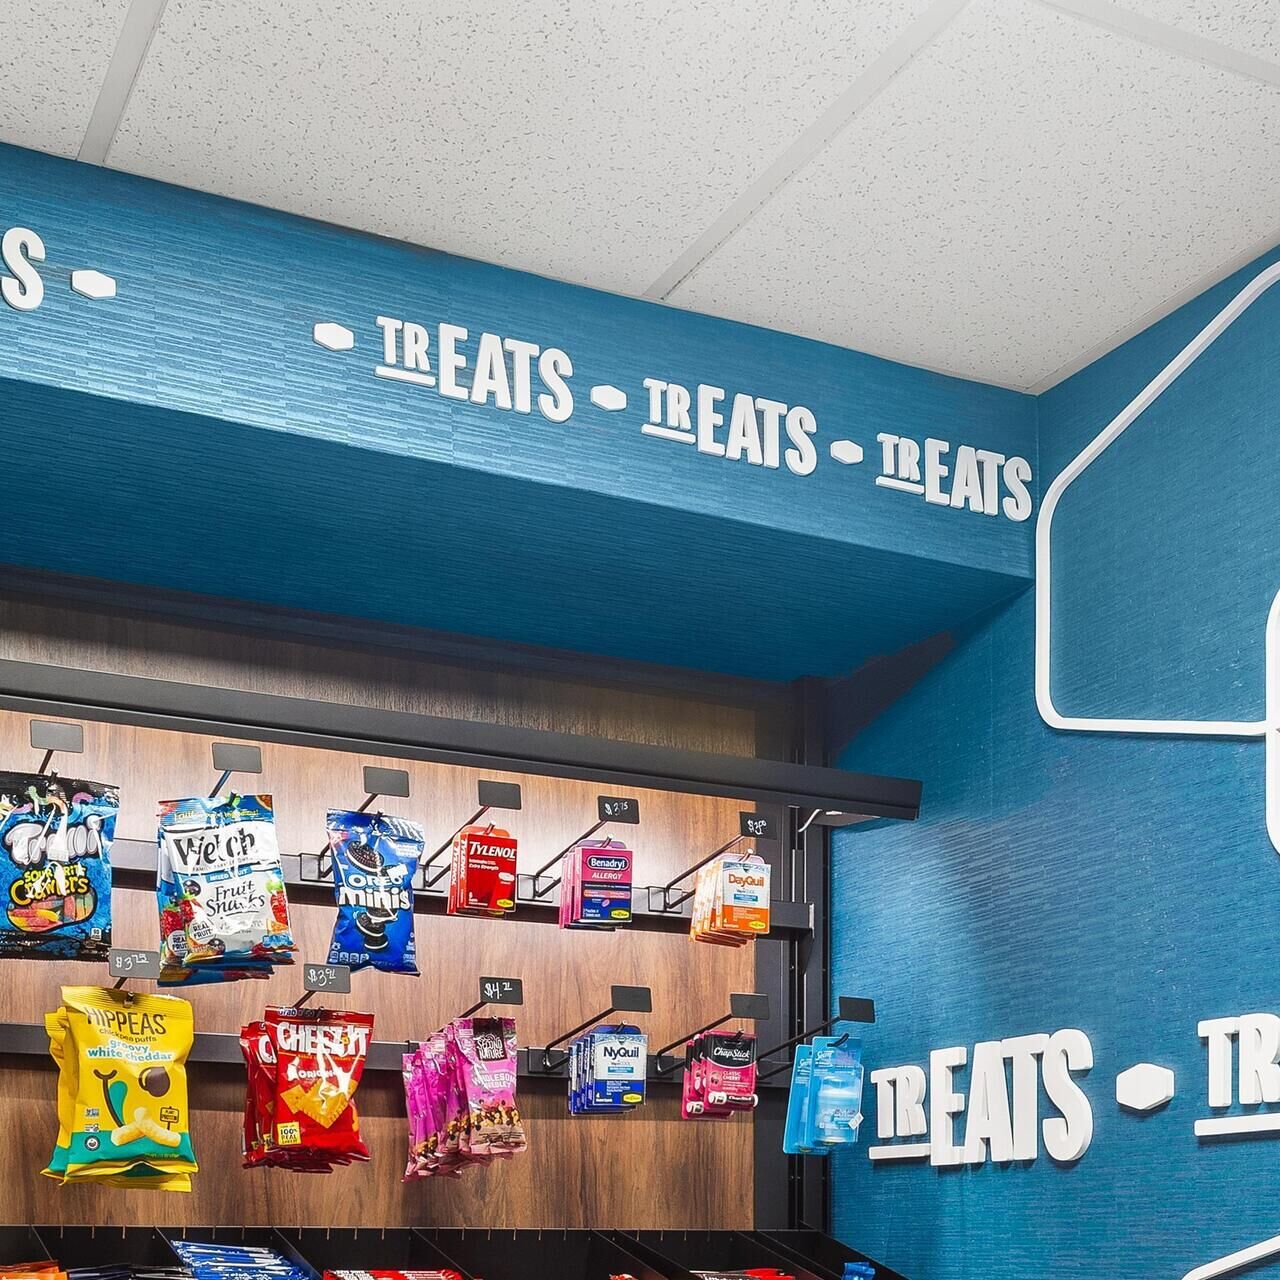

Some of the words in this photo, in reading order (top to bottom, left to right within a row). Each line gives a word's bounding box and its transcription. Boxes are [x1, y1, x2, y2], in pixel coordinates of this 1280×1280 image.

[375, 316, 574, 422] TREATS
[641, 378, 818, 476] TREATS
[876, 432, 1033, 522] TREATS
[469, 841, 517, 859] TYLENOL
[591, 857, 626, 870] Benadryl
[592, 872, 623, 880] ALLERGY
[728, 873, 765, 888] DayQuil
[215, 880, 255, 902] Fruit
[339, 886, 411, 909] minis
[192, 921, 210, 933] REAL
[193, 928, 213, 940] FRUIT
[84, 1006, 167, 1035] HIPPEAS
[476, 1037, 503, 1051] SECOND
[87, 1047, 123, 1058] white
[125, 1050, 173, 1062] cheddar
[603, 1046, 639, 1060] NyQuil
[714, 1047, 751, 1060] ChapStick
[869, 1029, 1094, 1167] TREATS
